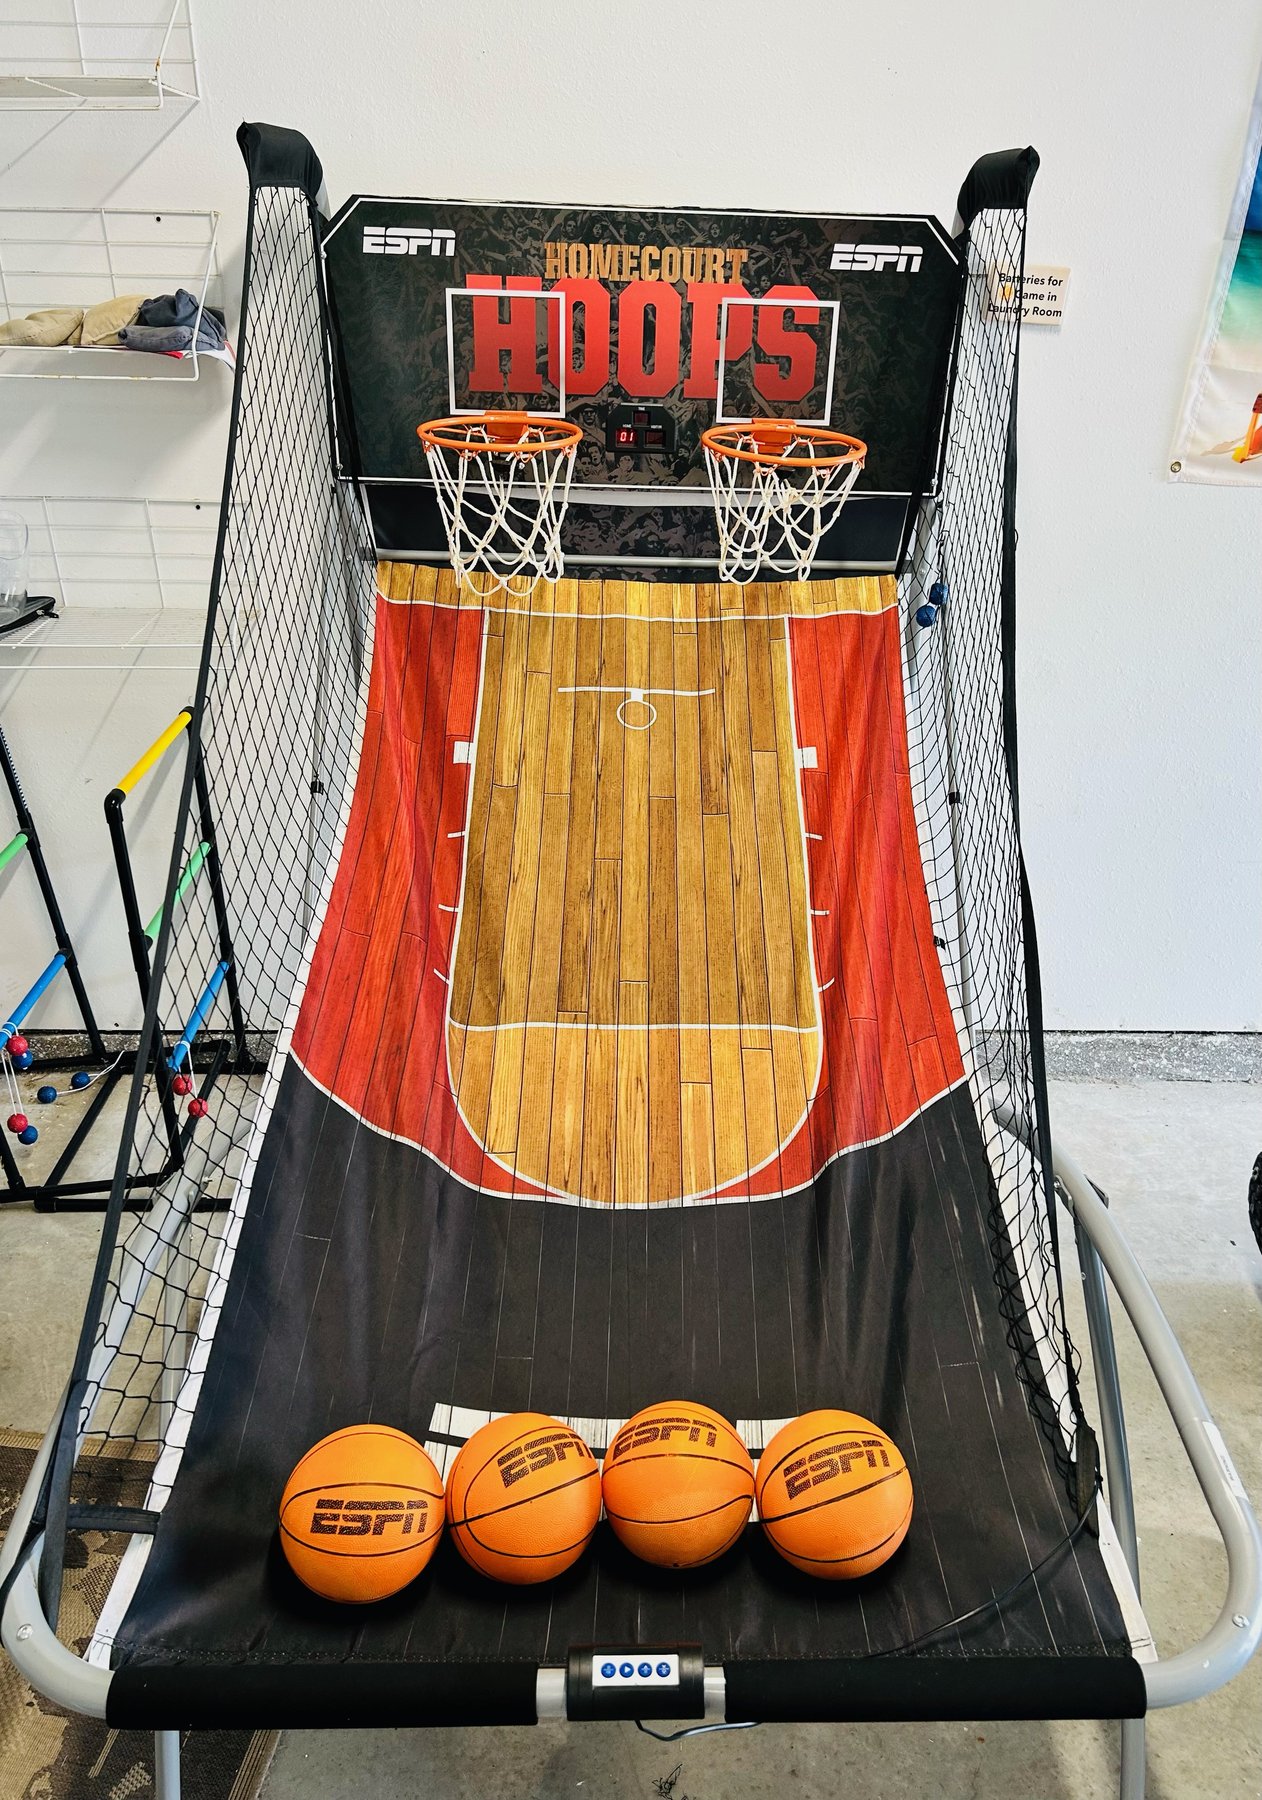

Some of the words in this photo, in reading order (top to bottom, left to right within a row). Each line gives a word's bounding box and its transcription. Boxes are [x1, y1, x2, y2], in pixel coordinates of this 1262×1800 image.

[362, 226, 456, 257] ESPN
[829, 243, 924, 273] ESPN
[543, 242, 749, 285] HOMECOURT
[999, 272, 1045, 286] Batteries
[1047, 275, 1063, 287] for
[1015, 289, 1045, 301] Game
[1047, 291, 1057, 302] in
[1032, 306, 1062, 317] Room
[466, 274, 820, 402] HOOPS
[620, 431, 634, 442] 01
[612, 1417, 718, 1461] ESPN
[497, 1432, 595, 1489] ESPN
[783, 1439, 891, 1500] ESPN
[309, 1499, 429, 1536] ESPN
